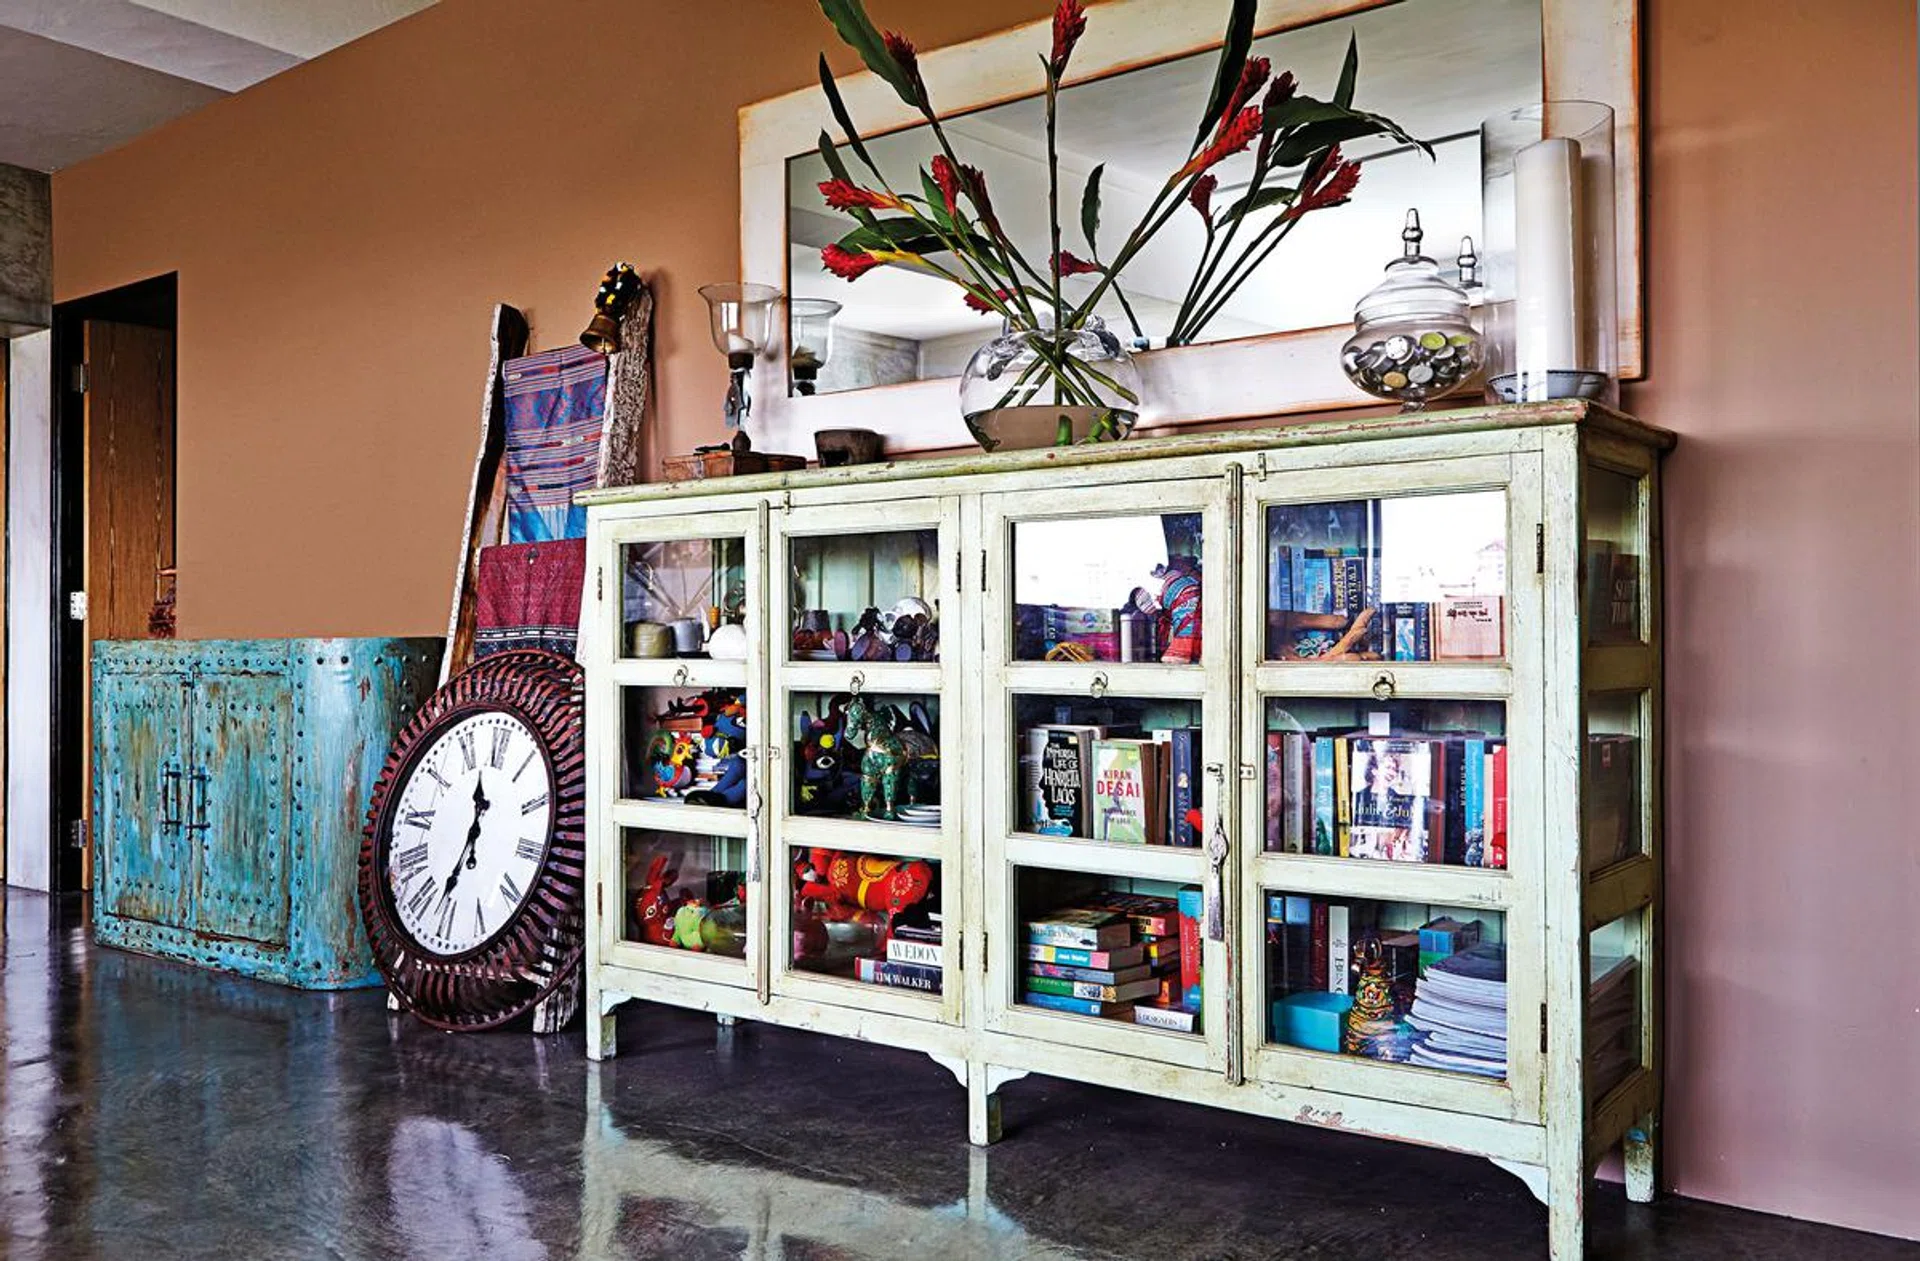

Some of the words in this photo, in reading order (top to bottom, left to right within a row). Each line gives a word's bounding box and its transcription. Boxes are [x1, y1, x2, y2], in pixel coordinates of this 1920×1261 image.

[1348, 564, 1358, 610] TWELVE
[1103, 769, 1133, 780] KIRAN
[1096, 780, 1141, 798] DESAI
[876, 971, 892, 985] TIM
[893, 973, 932, 990] WALKER
